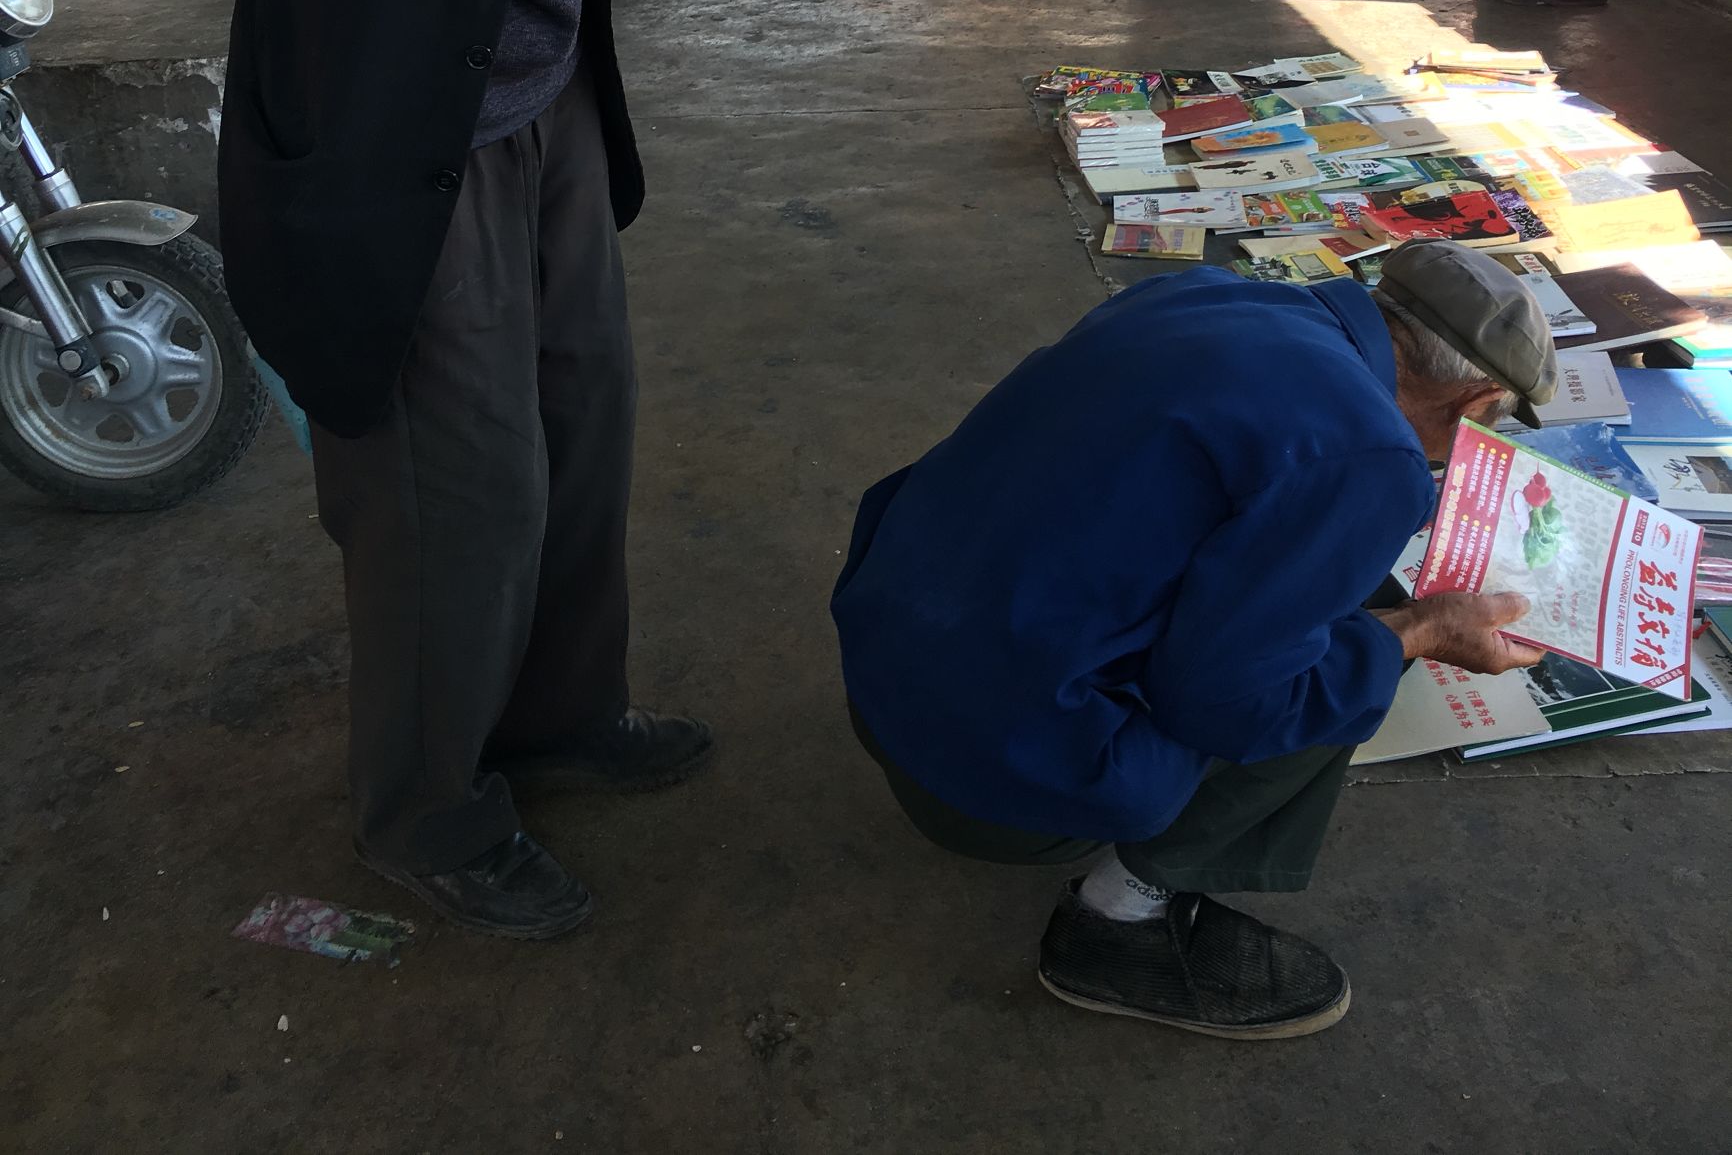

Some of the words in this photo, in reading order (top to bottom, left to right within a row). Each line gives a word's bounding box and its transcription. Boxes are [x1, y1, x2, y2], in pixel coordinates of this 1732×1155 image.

[1618, 548, 1634, 604] PROLONGING
[1617, 603, 1626, 621] LIFE
[1630, 559, 1677, 670] 益寿文摘
[1614, 621, 1624, 666] ABSTRACTS
